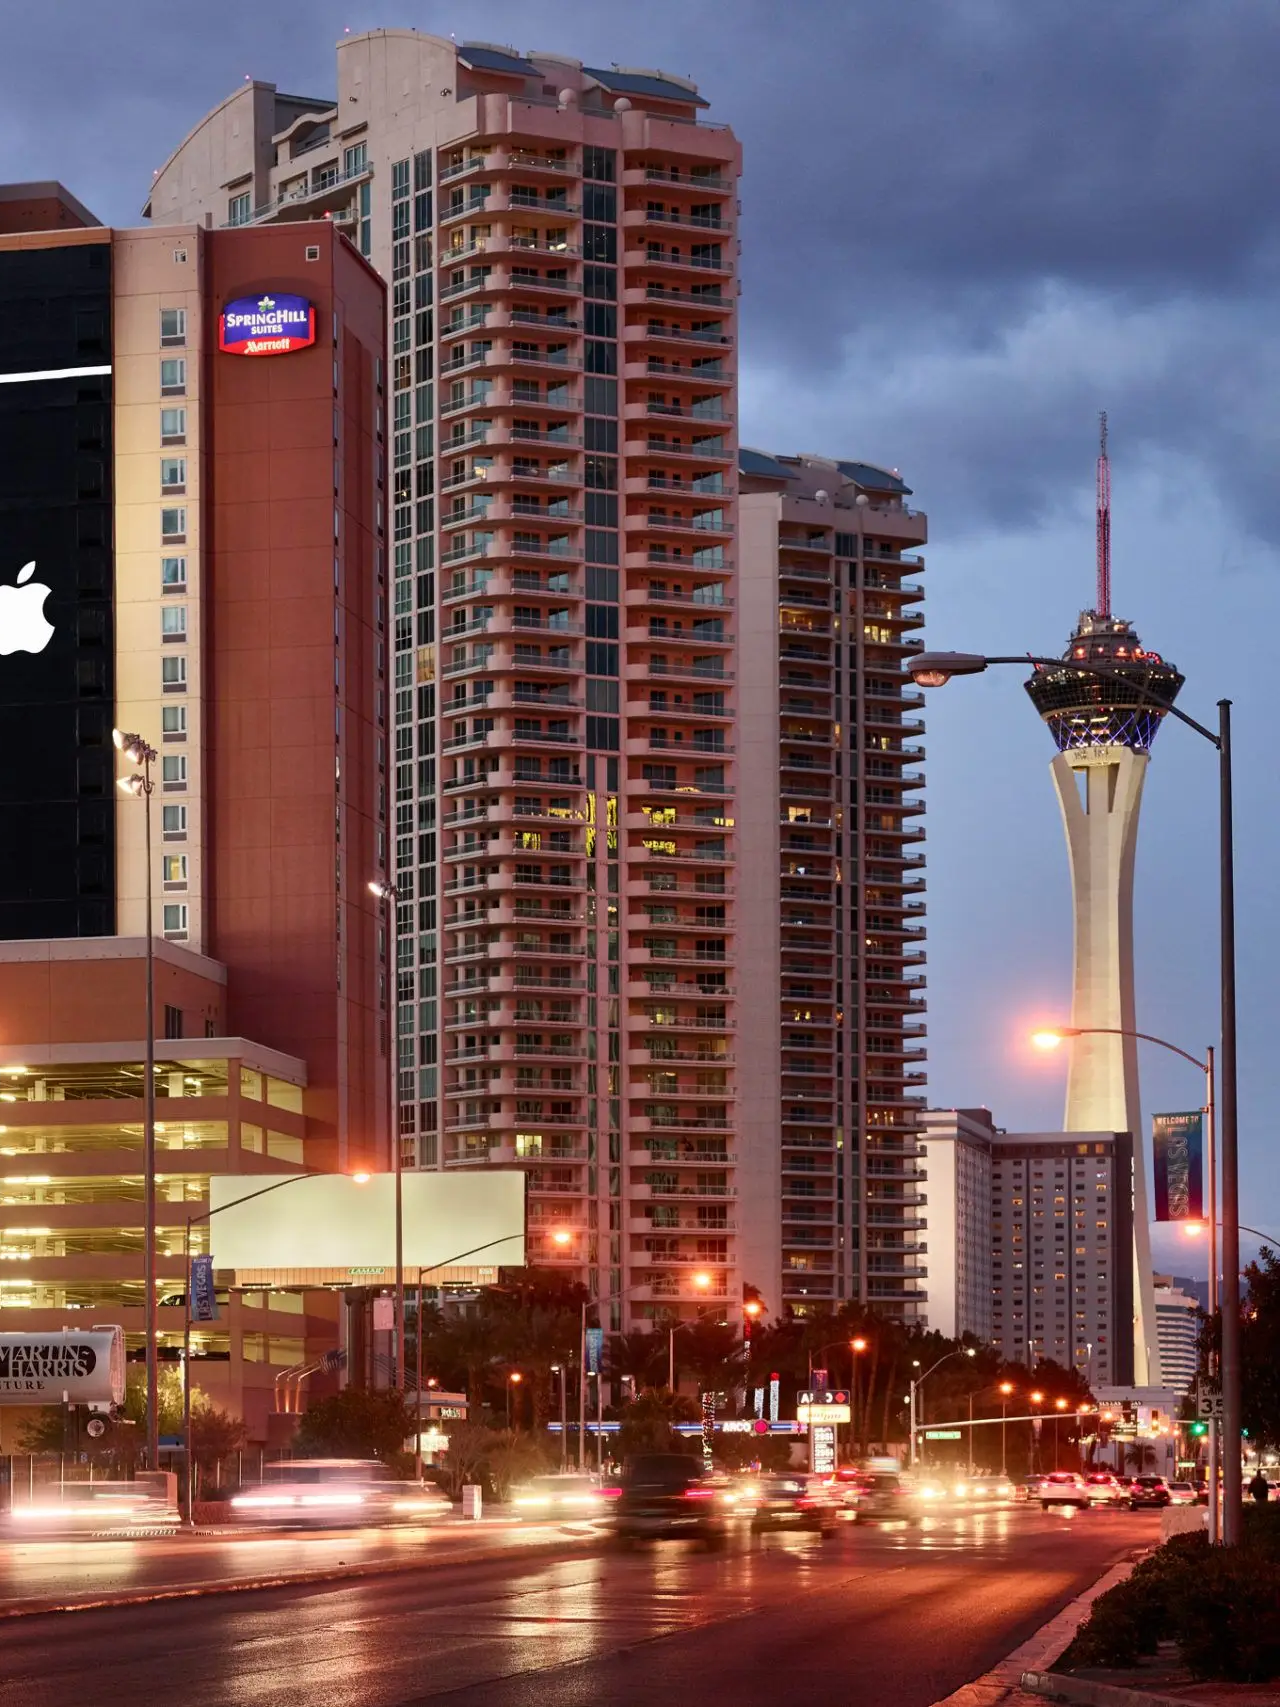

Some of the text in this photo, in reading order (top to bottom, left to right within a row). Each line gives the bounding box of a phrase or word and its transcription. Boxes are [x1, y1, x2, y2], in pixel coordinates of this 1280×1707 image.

[251, 324, 283, 335] SUITES
[244, 338, 290, 354] Marriott
[1157, 1116, 1189, 1125] WELCOME
[1168, 1127, 1189, 1217] LAS VEGAS
[8, 1360, 88, 1377] HARRIS
[722, 1421, 751, 1432] ARCO
